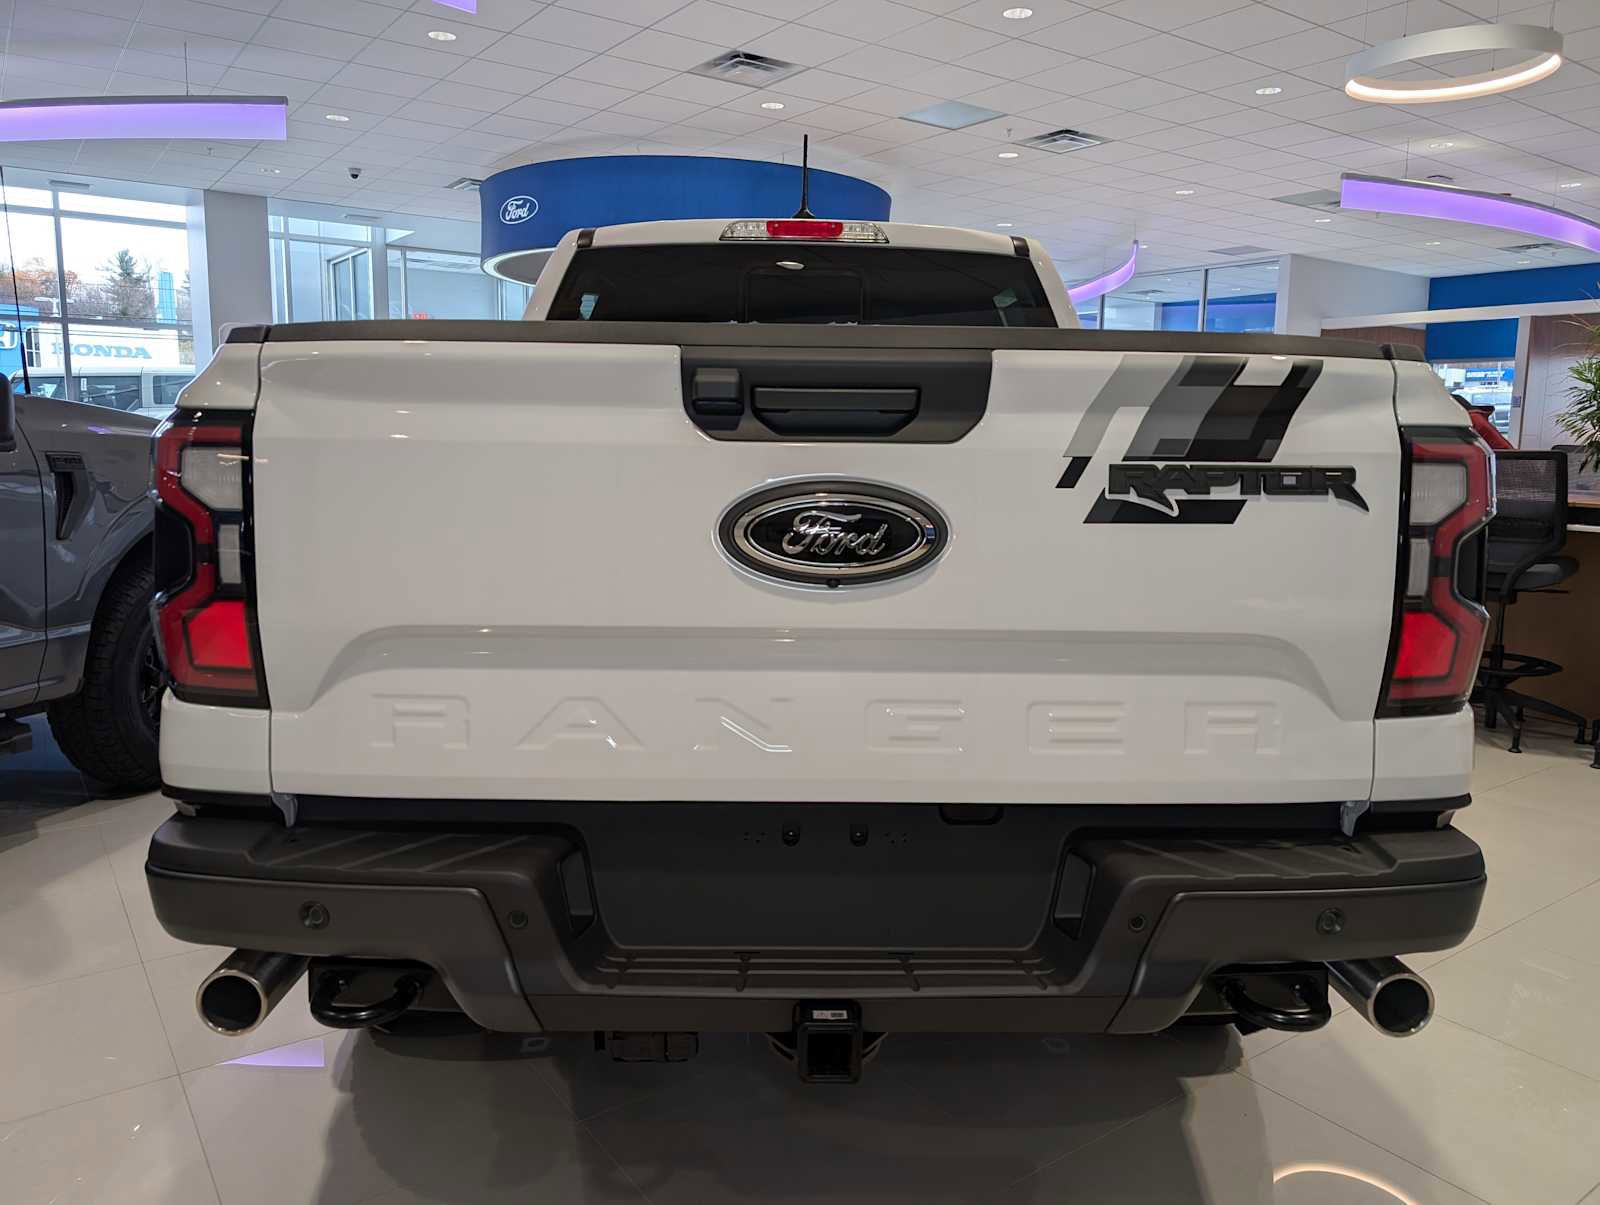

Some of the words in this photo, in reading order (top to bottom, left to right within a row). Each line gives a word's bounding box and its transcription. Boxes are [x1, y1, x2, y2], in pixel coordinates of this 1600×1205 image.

[506, 200, 530, 220] Ford
[1108, 463, 1369, 512] RAPTOR
[782, 510, 888, 555] Ford
[368, 693, 1281, 756] RANGER
